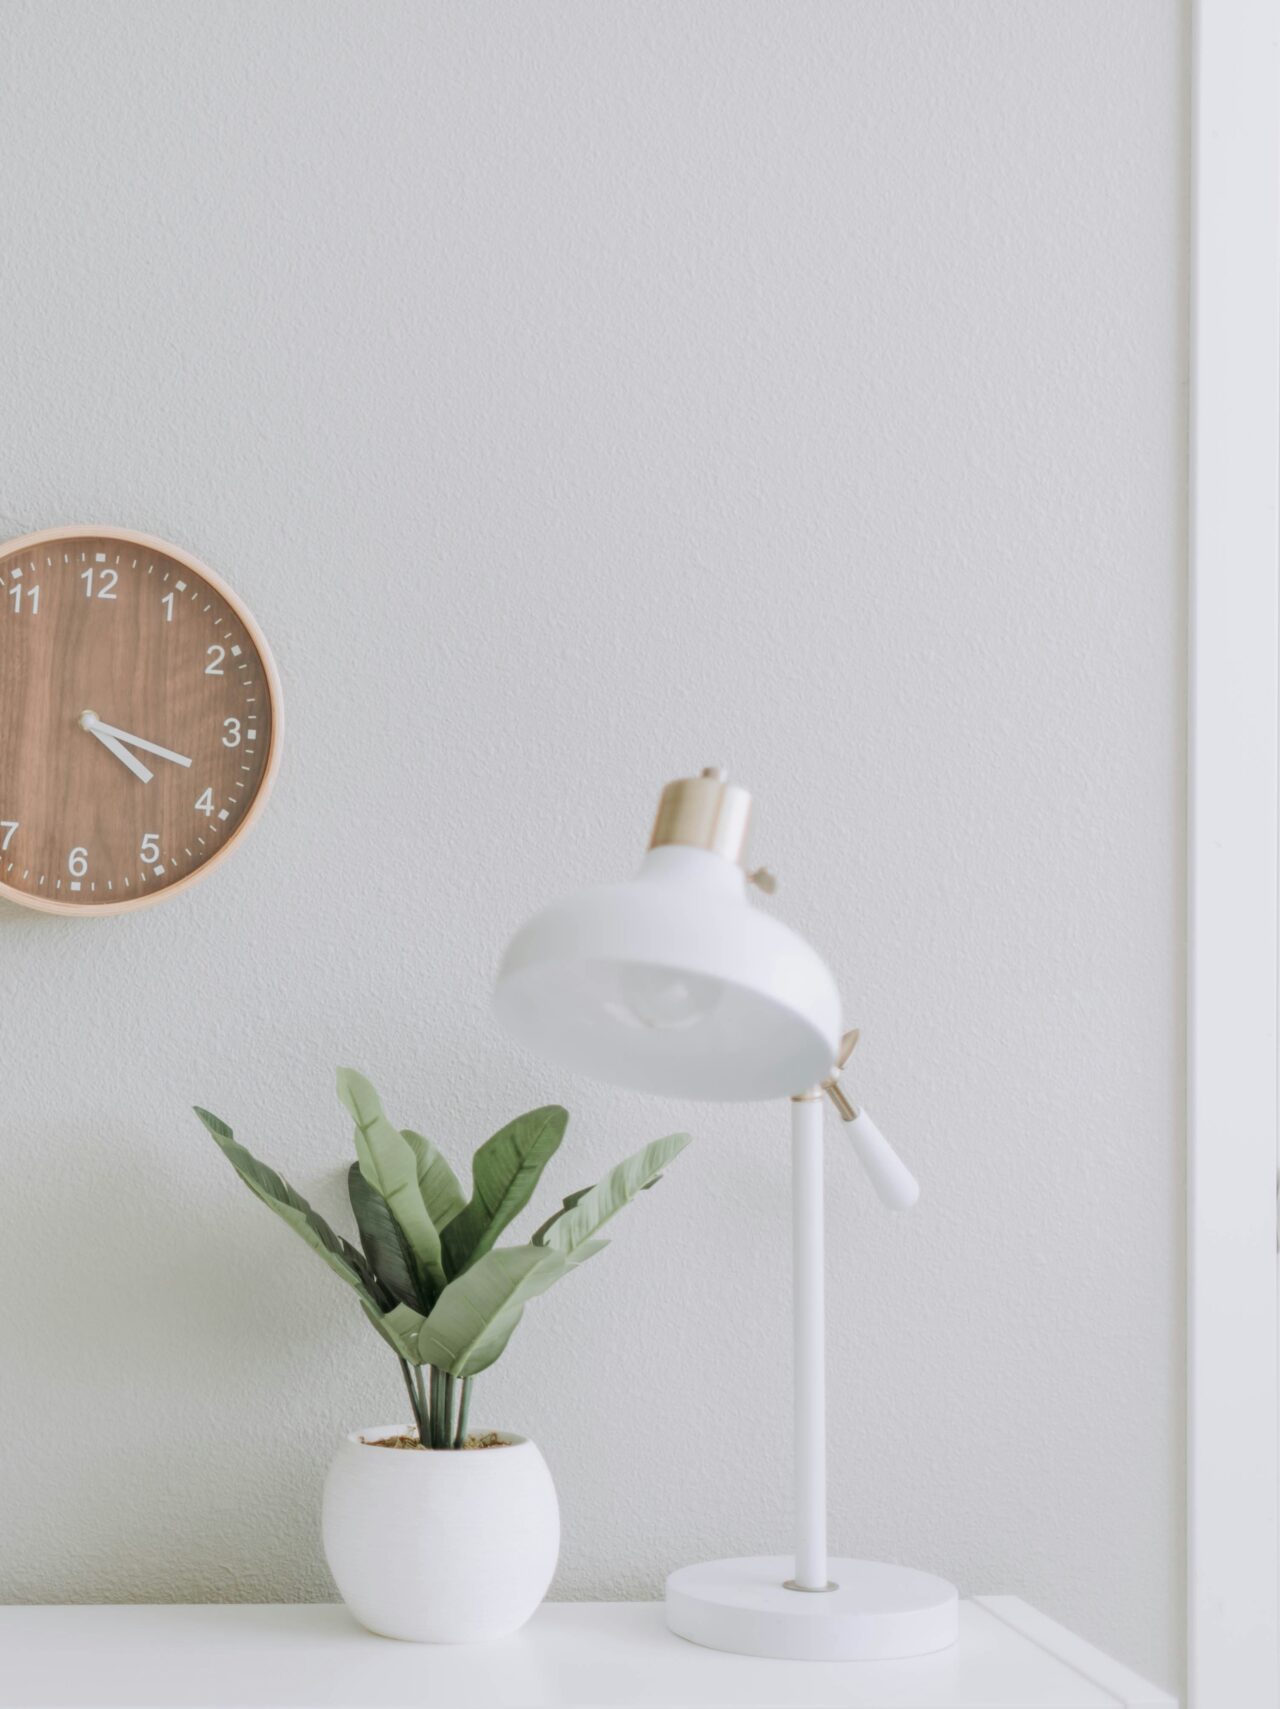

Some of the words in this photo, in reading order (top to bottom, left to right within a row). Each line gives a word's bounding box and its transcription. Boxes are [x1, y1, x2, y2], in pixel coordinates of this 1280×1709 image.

[80, 567, 118, 600] 12
[9, 584, 40, 615] 11
[161, 592, 174, 622] 1
[205, 645, 225, 675] 2
[222, 718, 241, 748] 3
[195, 787, 215, 817] 4
[0, 821, 19, 850] 7
[140, 834, 160, 864] 5
[68, 846, 89, 877] 6
